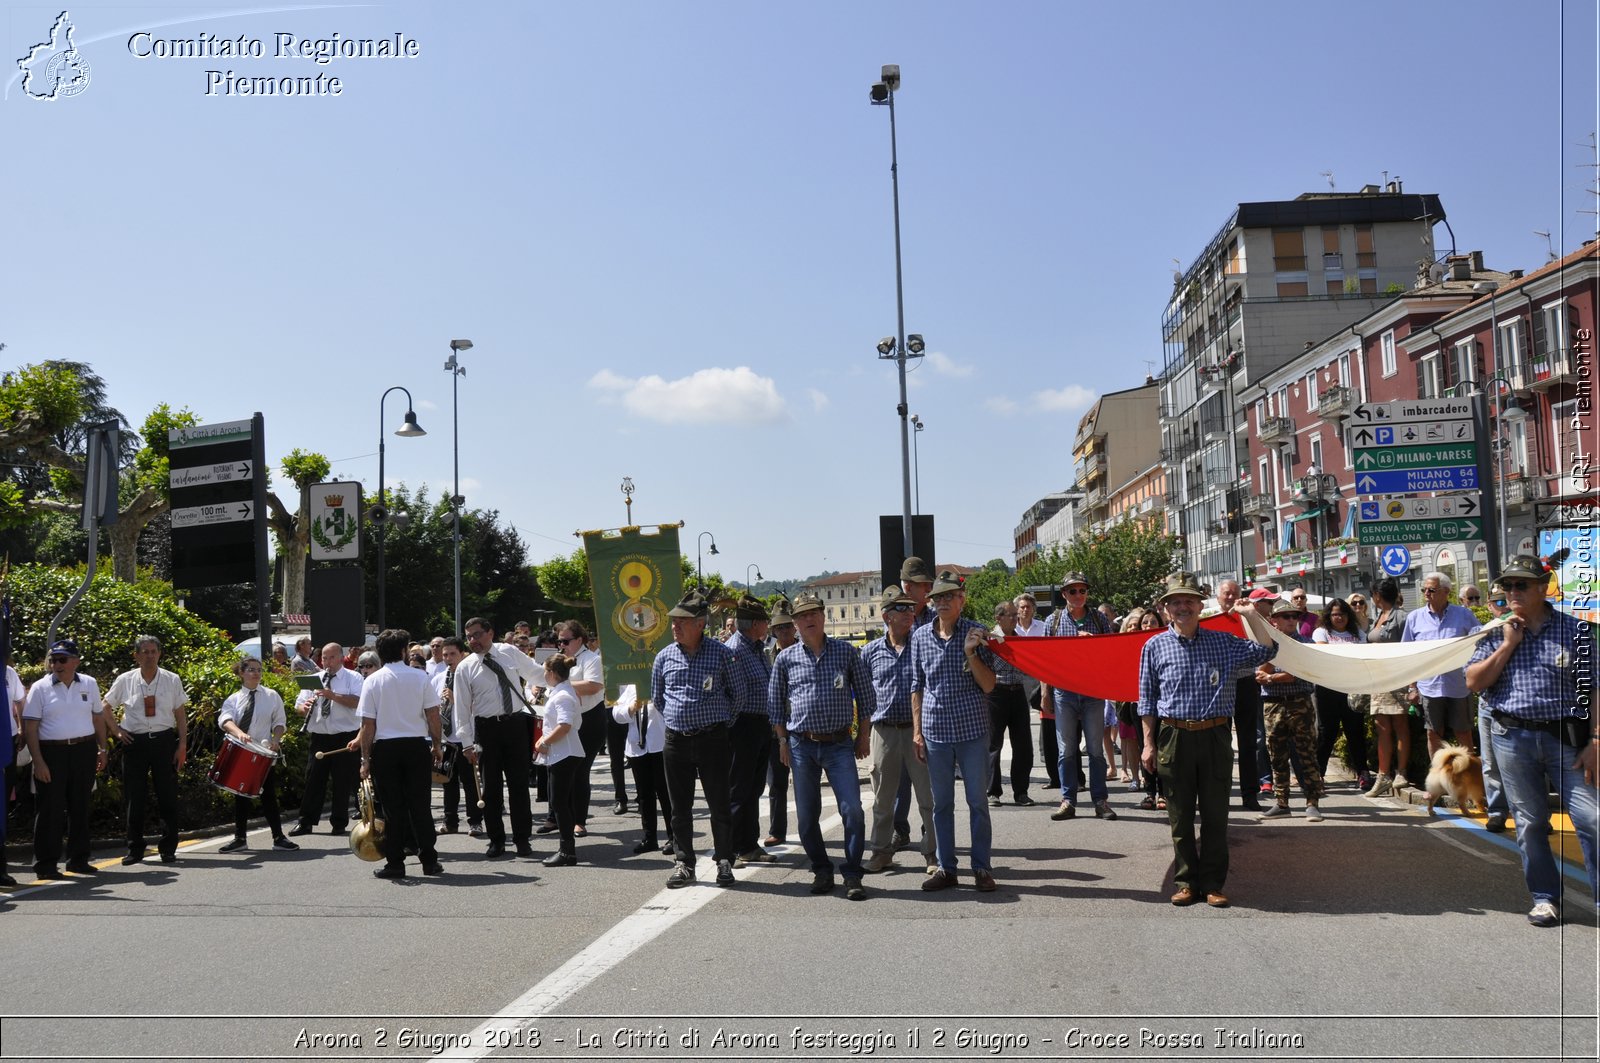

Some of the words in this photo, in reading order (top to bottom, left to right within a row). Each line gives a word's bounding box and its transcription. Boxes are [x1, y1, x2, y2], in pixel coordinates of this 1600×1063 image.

[1403, 404, 1468, 416] imbarcadero
[192, 430, 208, 439] Città
[220, 426, 241, 434] Arona
[1379, 430, 1389, 442] P
[1380, 454, 1392, 463] A8
[1396, 450, 1472, 463] MILANO-VARESE
[1407, 469, 1451, 480] MILANO
[1459, 469, 1473, 477] 64
[1408, 479, 1454, 490] NOVARA
[1461, 478, 1474, 487] 37
[201, 507, 214, 515] 100
[216, 506, 227, 514] mt.
[1442, 526, 1457, 534] A26
[1362, 533, 1422, 543] GRAVELLONA
